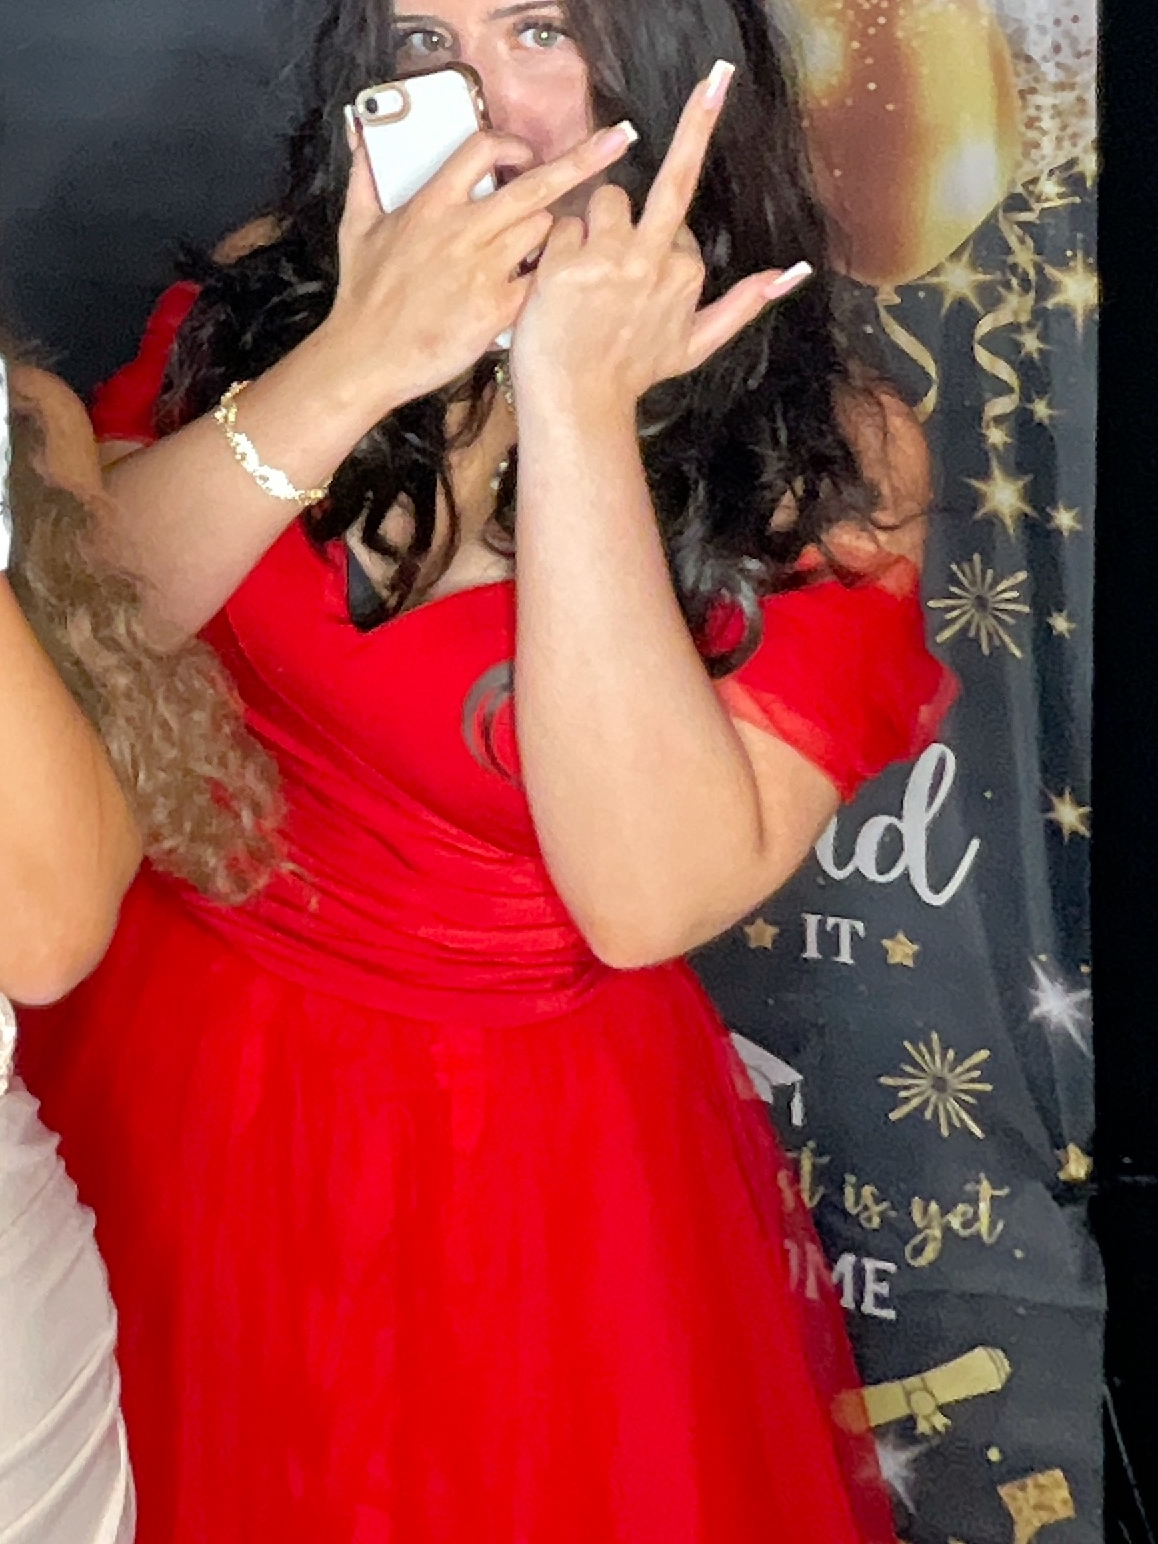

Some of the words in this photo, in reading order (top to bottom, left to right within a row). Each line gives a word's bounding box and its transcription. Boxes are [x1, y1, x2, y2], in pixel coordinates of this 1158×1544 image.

[801, 913, 865, 964] IT
[843, 1173, 898, 1231] is
[905, 1172, 1010, 1268] yet
